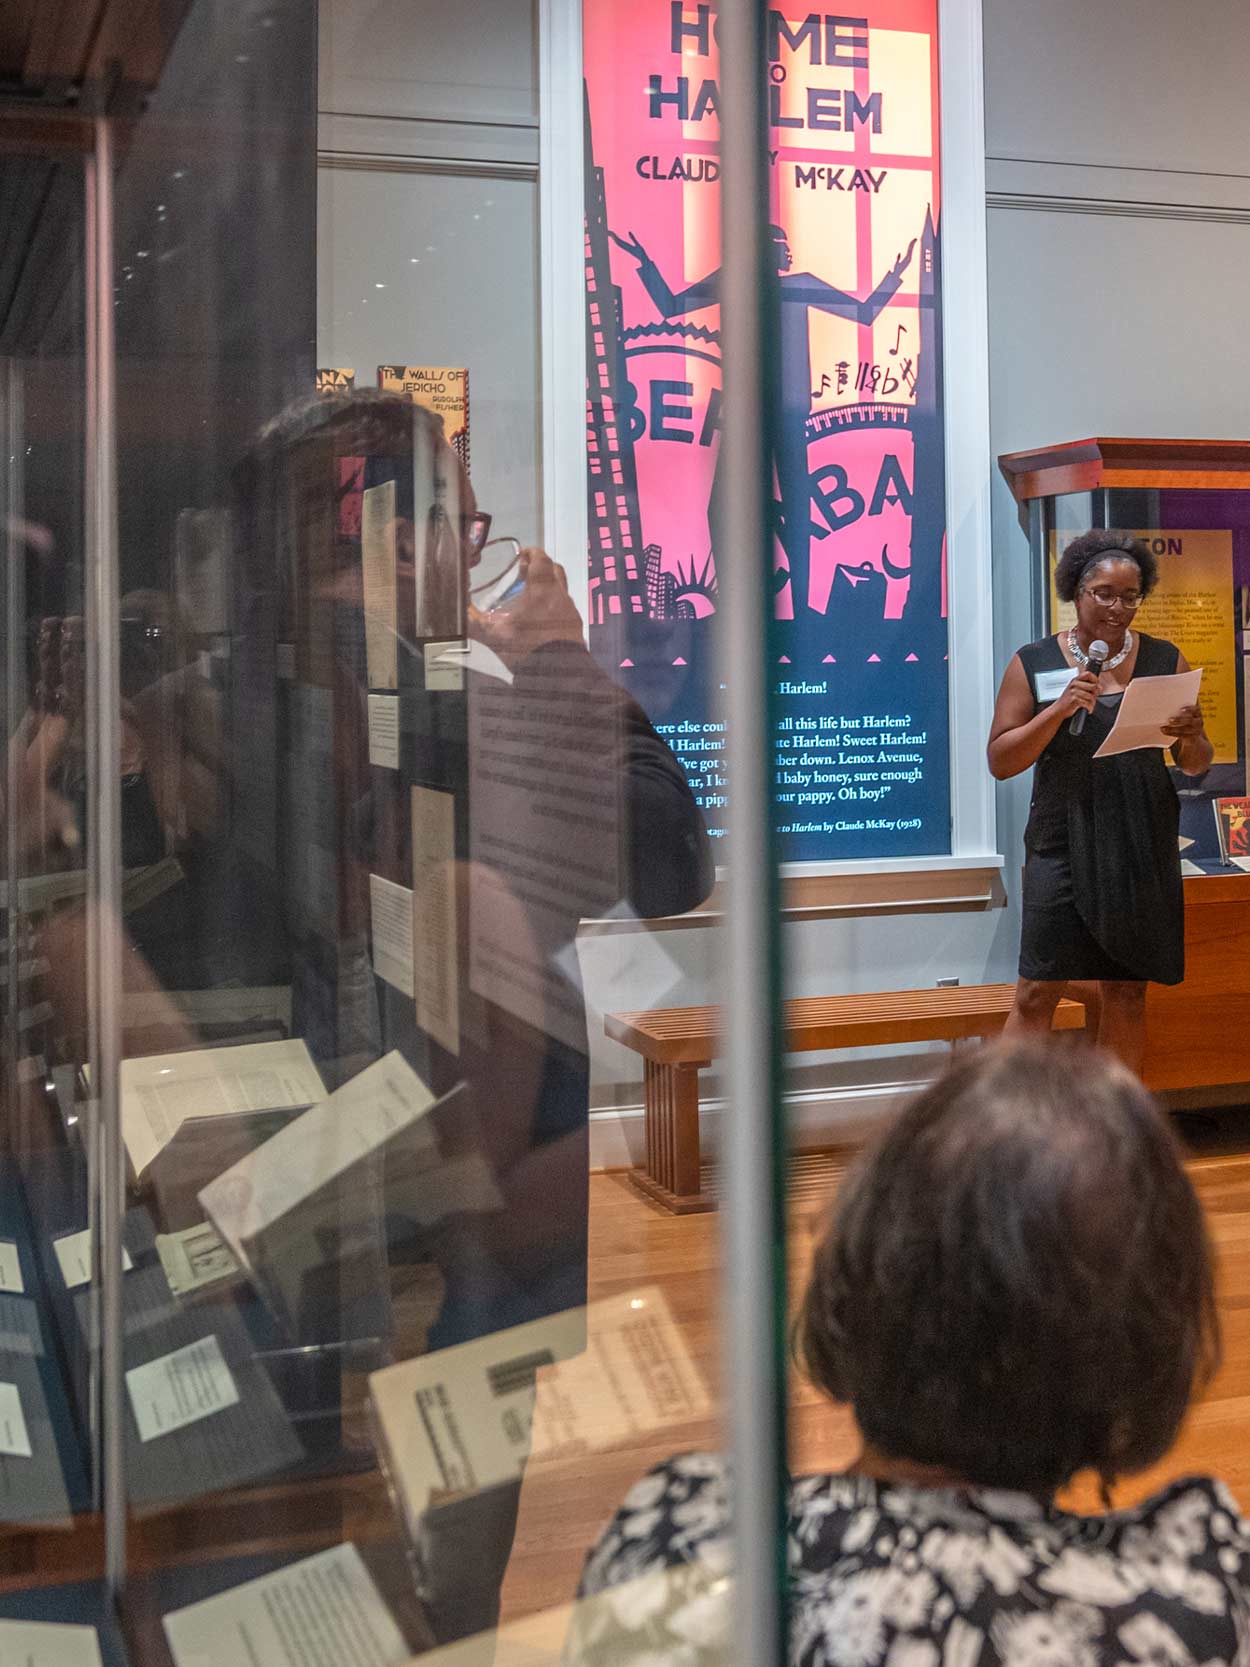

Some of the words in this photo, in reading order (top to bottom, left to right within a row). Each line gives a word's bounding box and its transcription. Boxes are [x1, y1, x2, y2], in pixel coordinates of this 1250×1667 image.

[671, 1, 869, 68] HME
[649, 74, 883, 134] HALEM
[636, 156, 720, 182] CLAUD
[409, 371, 444, 381] WALLS
[447, 371, 464, 381] OF
[401, 382, 446, 393] JERICHO
[779, 681, 828, 695] Harlem!
[677, 720, 701, 733] else
[778, 717, 793, 730] all
[795, 717, 817, 729] this
[819, 716, 838, 729] life
[840, 716, 861, 729] but
[862, 714, 911, 728] Harlem?
[677, 738, 727, 752] Harlem!
[792, 734, 840, 748] Harlem!
[842, 734, 878, 746] Sweet
[880, 731, 927, 745] Harlem!
[700, 760, 719, 773] got
[799, 752, 837, 766] down.
[838, 752, 875, 764] Lenox
[877, 750, 924, 764] Avenue,
[706, 774, 712, 786] I
[784, 770, 811, 787] baby
[813, 770, 851, 785] honey,
[854, 772, 879, 782] sure
[880, 767, 923, 783] enough
[696, 796, 703, 806] a
[776, 791, 796, 802] our
[797, 791, 836, 805] pappy.
[838, 787, 858, 800] Oh
[781, 825, 791, 833] to
[791, 822, 822, 833] Harlem
[823, 821, 834, 834] by
[835, 820, 865, 831] Claude
[866, 819, 895, 831] McKay
[896, 818, 922, 830] (1928)
